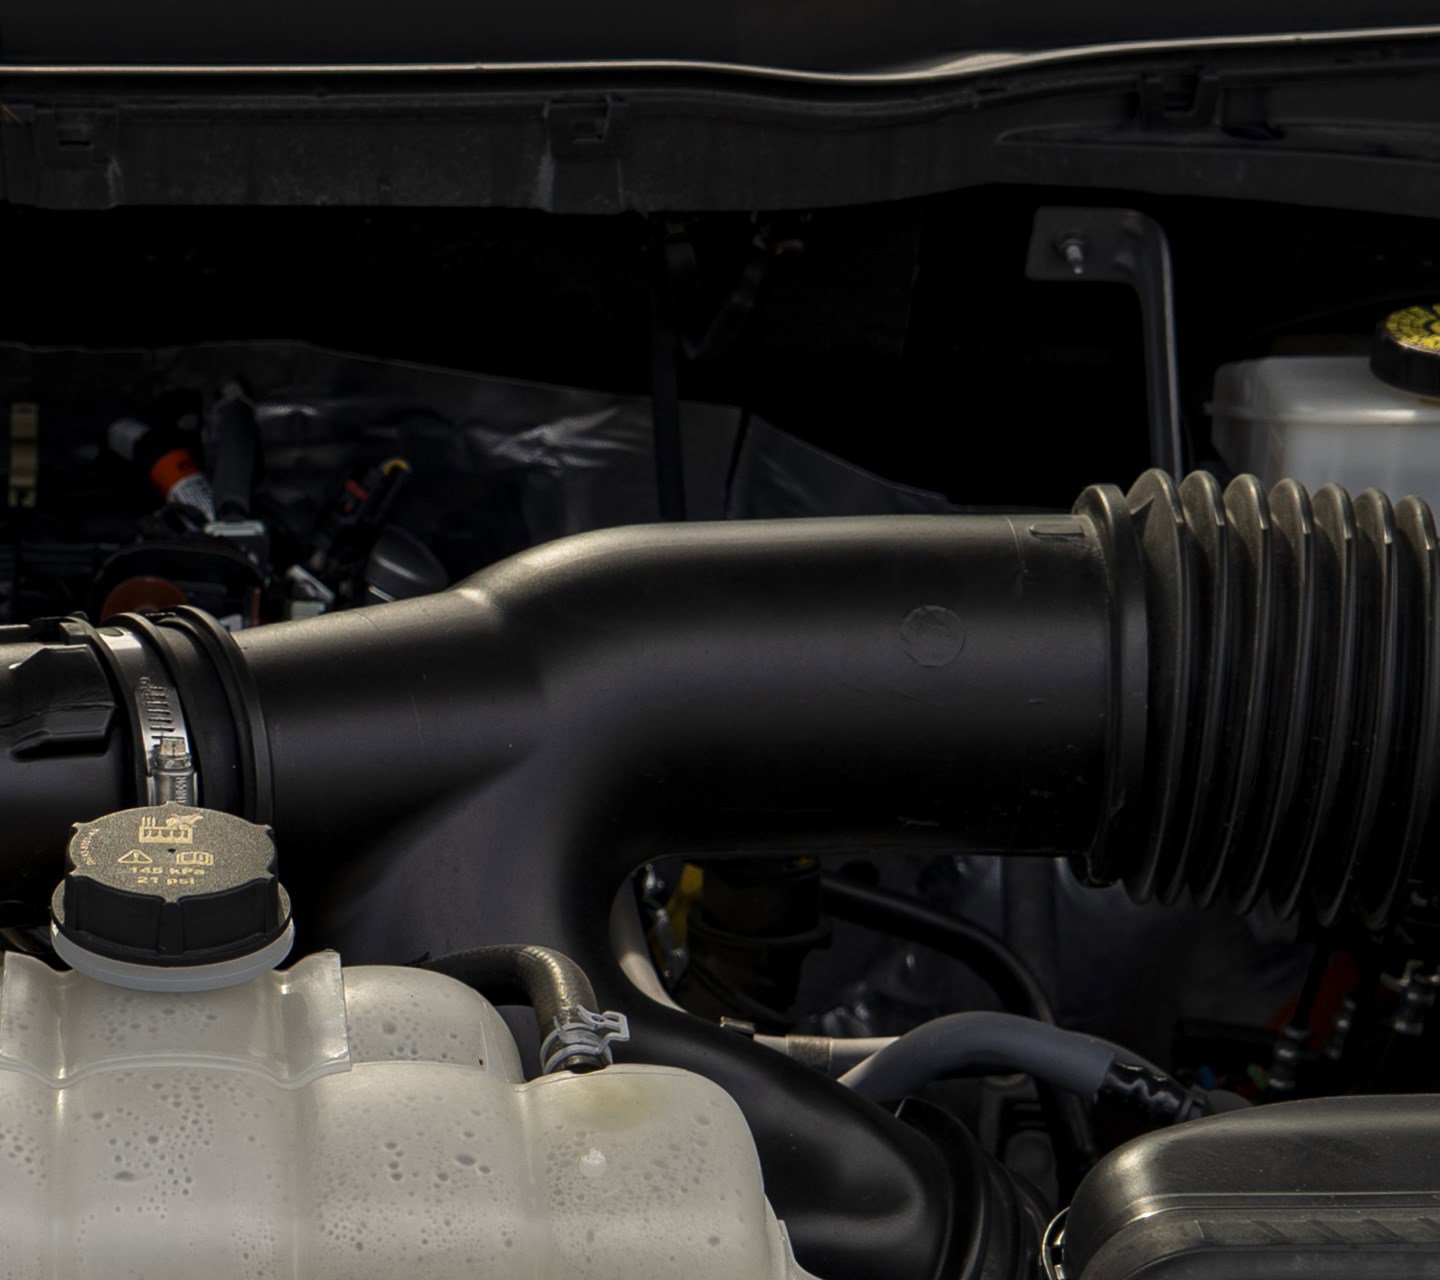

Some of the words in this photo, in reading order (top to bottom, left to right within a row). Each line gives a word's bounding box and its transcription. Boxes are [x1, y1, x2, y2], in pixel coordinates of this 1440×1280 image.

[128, 866, 164, 875] 145
[169, 866, 206, 876] kPa
[137, 876, 161, 885] 21
[166, 876, 196, 886] psi
